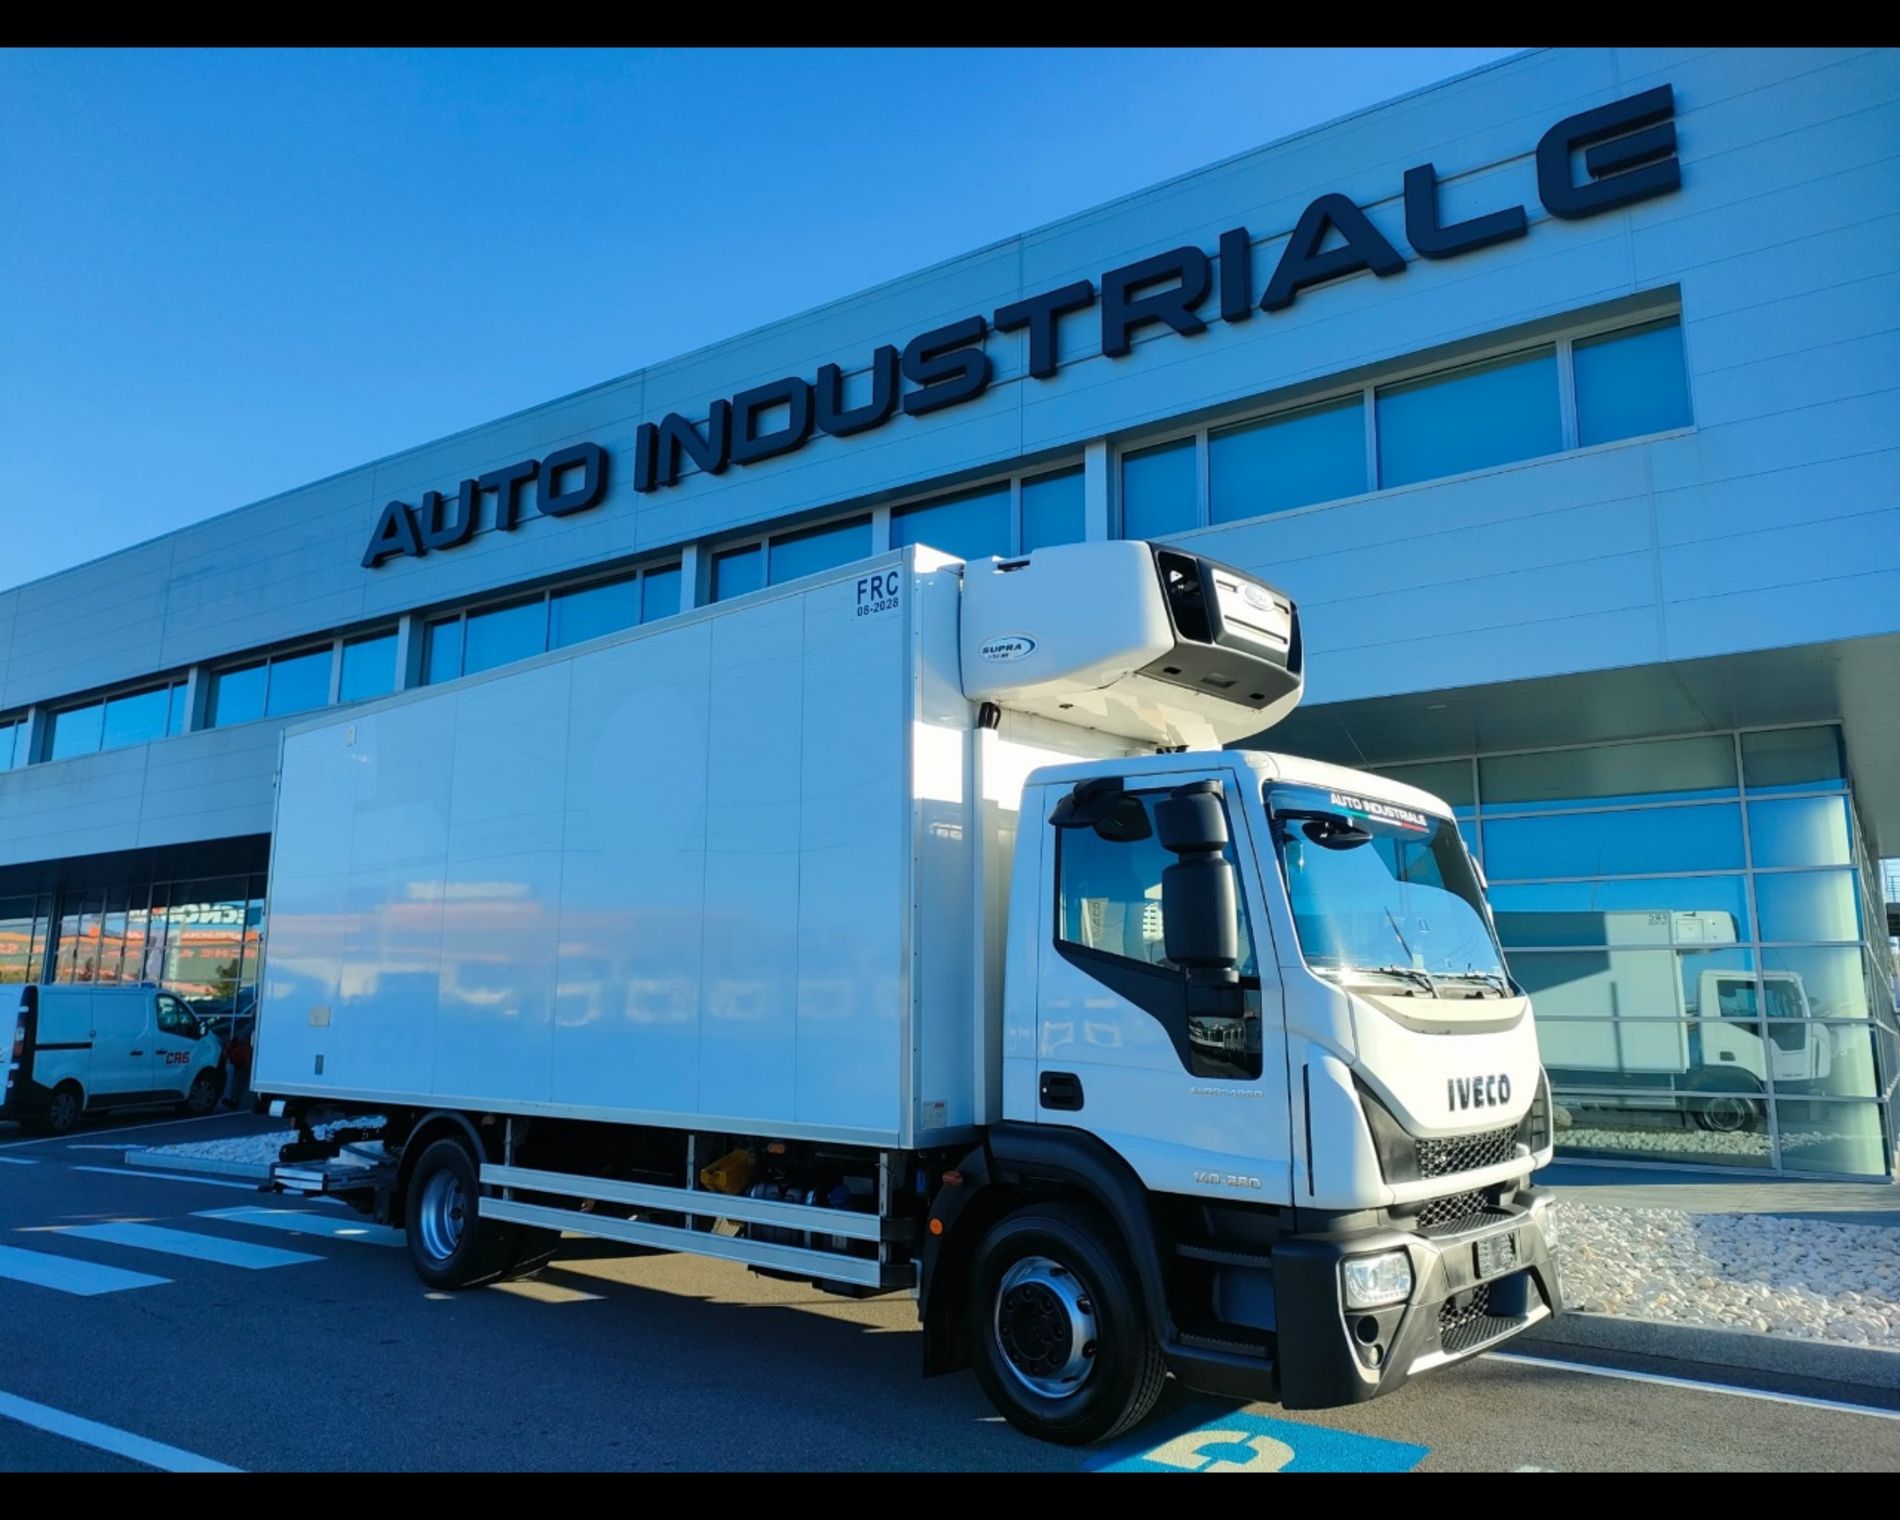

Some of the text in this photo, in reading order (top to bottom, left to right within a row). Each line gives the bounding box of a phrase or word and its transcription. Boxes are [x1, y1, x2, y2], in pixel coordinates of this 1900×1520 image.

[361, 82, 1682, 568] AUTO INDUSTRIALE
[857, 571, 899, 605] FRC
[857, 596, 899, 616] 08-2028
[982, 643, 1022, 654] SUPRA
[1331, 792, 1428, 826] AUTO INDUSTRIALE
[1447, 1073, 1512, 1112] IVECO
